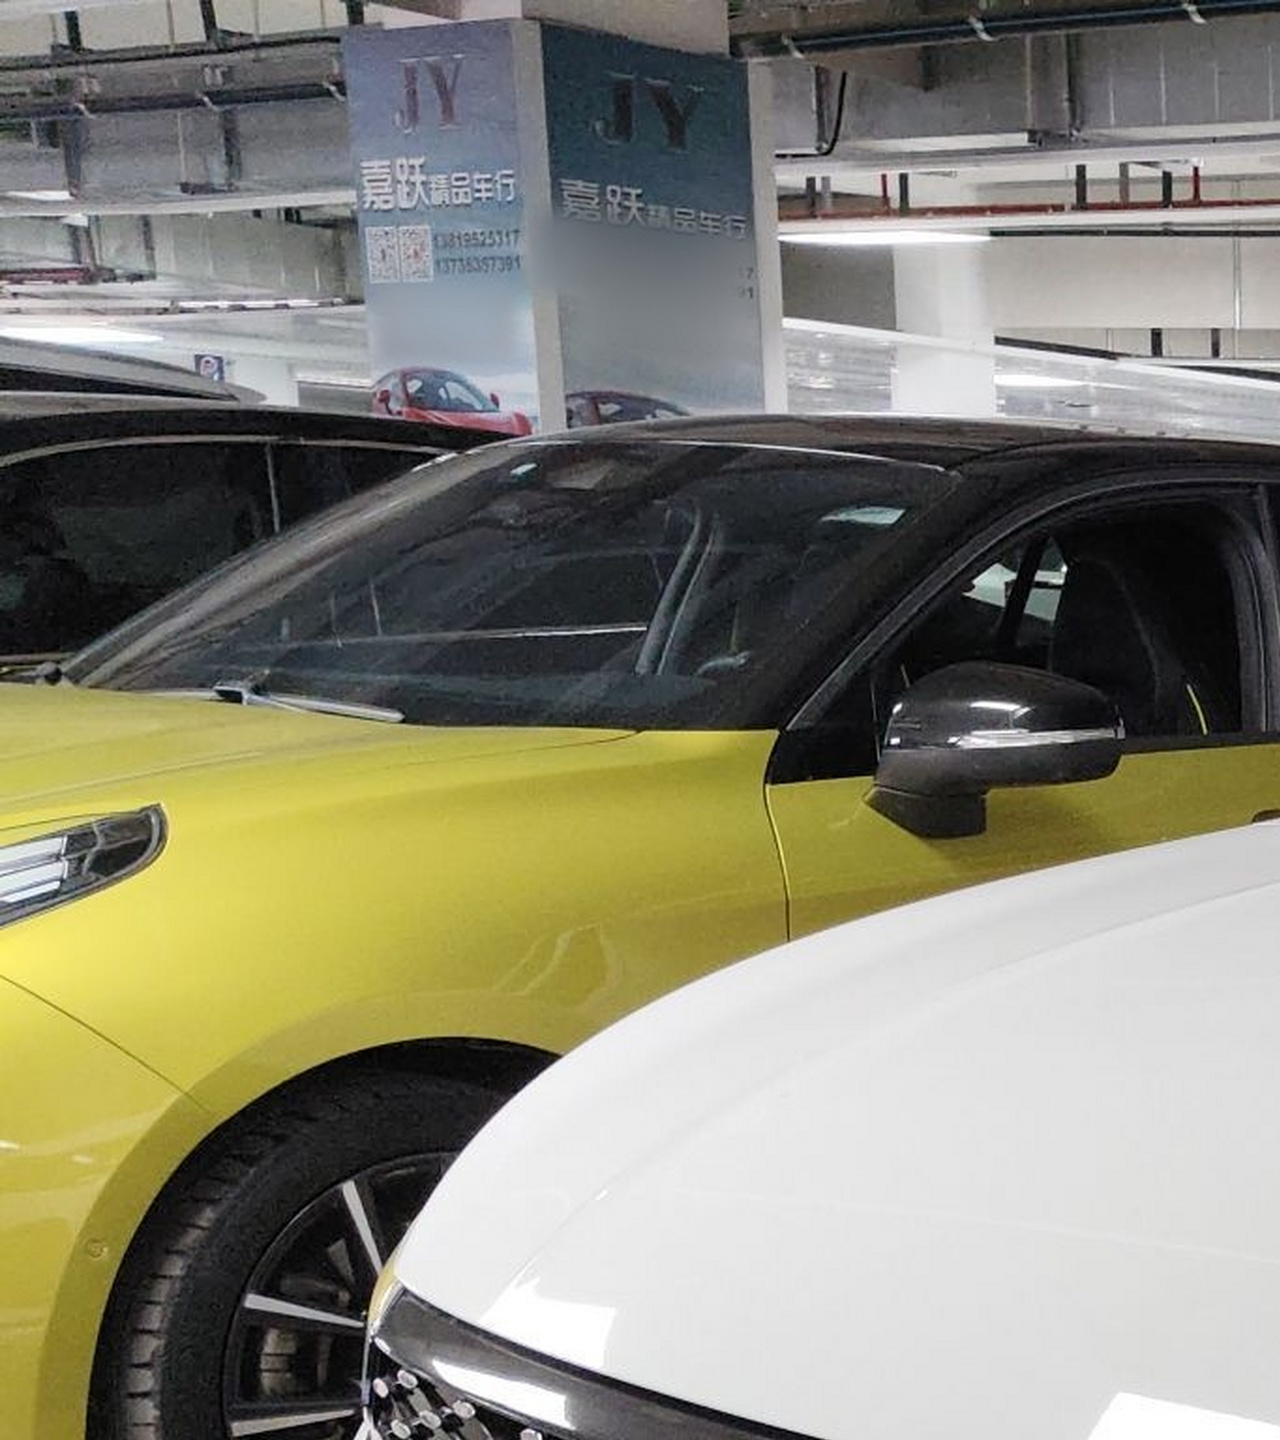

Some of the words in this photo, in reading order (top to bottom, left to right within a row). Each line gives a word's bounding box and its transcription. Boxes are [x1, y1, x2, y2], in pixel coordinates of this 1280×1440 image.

[391, 53, 465, 135] JY
[593, 70, 705, 153] JY
[360, 156, 516, 211] 嘉跃精品车行
[559, 178, 748, 239] 嘉跃精品车行
